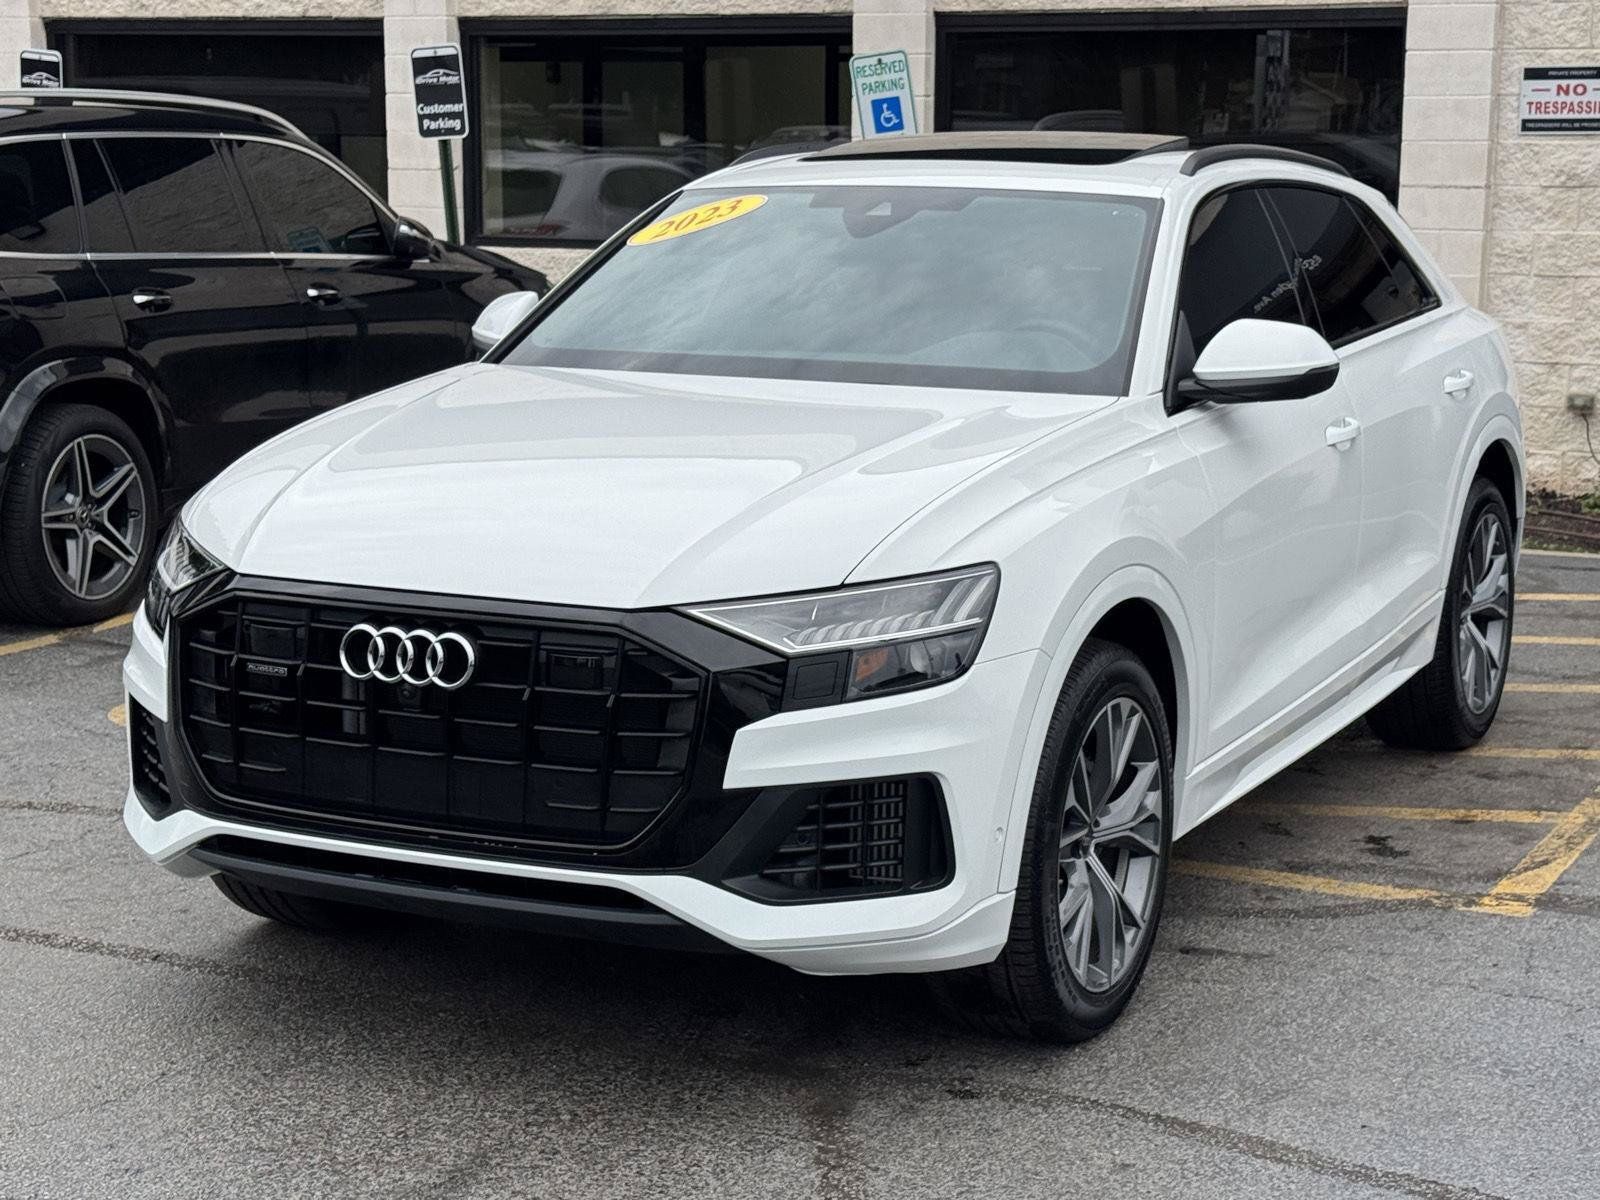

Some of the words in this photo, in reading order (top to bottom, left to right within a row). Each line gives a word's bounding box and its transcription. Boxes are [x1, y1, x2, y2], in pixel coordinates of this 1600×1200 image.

[855, 60, 905, 79] RESERVED
[861, 78, 905, 96] PARKING
[1556, 84, 1588, 97] NO
[417, 103, 464, 115] Customer
[1526, 101, 1600, 115] TRESPASSI
[423, 118, 462, 131] Parking
[651, 199, 743, 240] 2023
